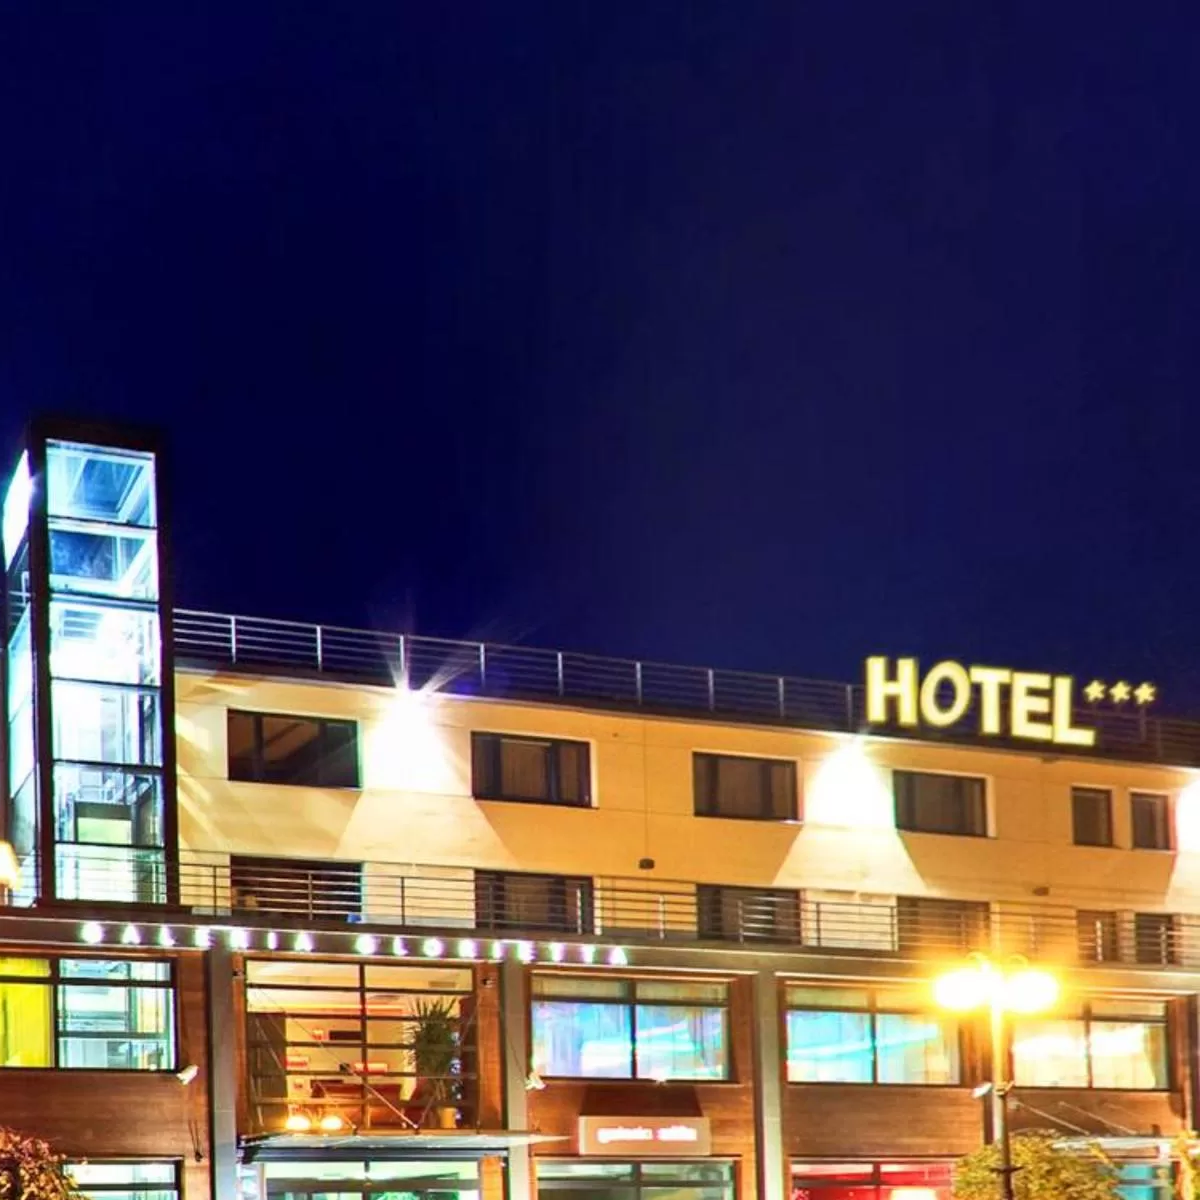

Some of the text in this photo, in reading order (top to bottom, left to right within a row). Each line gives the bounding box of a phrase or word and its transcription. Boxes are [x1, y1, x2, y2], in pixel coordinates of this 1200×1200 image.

[864, 656, 1096, 746] HOTEL
[81, 922, 628, 965] GALERIA GLORIETTA
